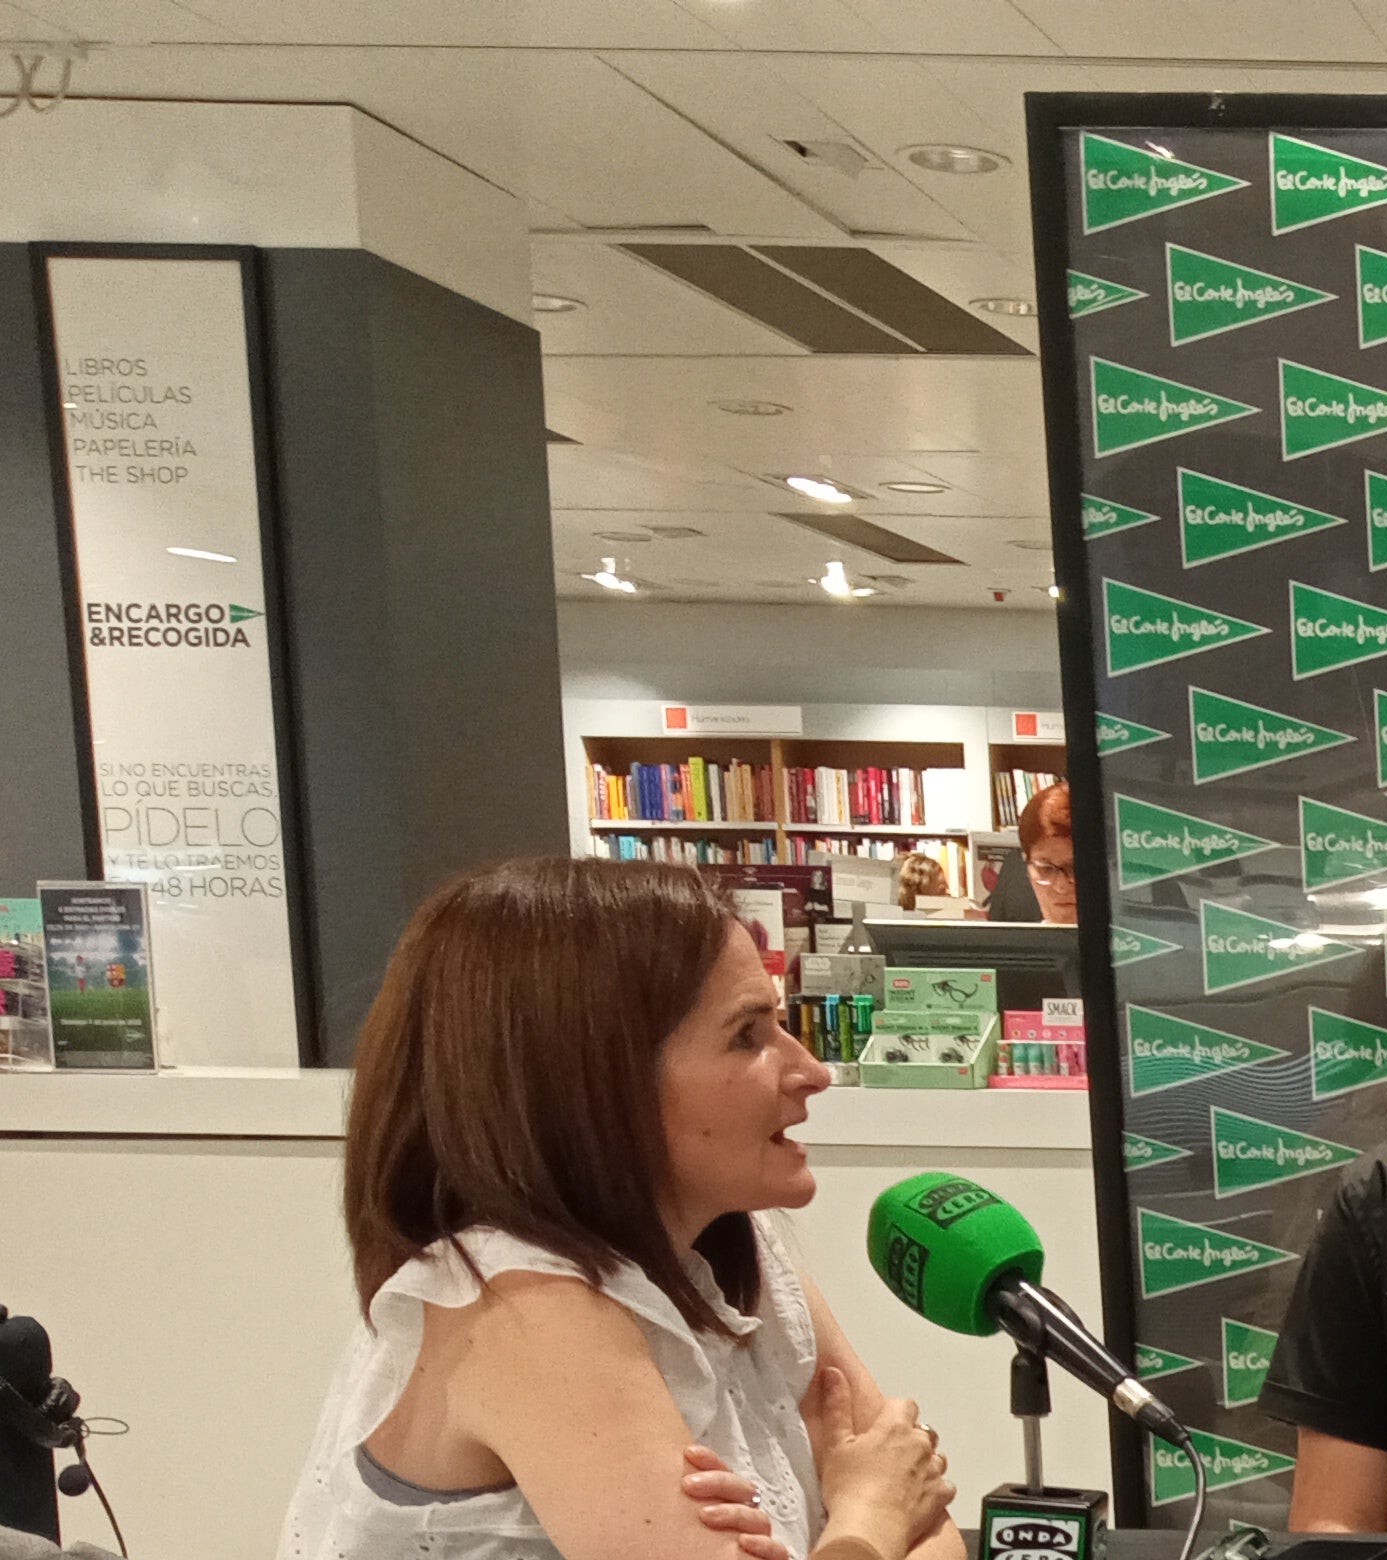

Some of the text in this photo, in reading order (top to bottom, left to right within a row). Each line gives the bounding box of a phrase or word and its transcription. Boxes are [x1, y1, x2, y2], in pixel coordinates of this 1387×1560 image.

[1086, 170, 1105, 190] El
[1106, 170, 1148, 190] Corte
[1276, 171, 1294, 191] El
[1295, 171, 1338, 191] Corte
[1173, 282, 1191, 302] El
[1192, 282, 1235, 302] Corte
[64, 358, 148, 376] LIBROS
[68, 382, 192, 404] PELÍCULAS
[1097, 395, 1115, 415] El
[1116, 395, 1159, 415] Corte
[1285, 397, 1304, 417] El
[1304, 398, 1346, 417] Corte
[71, 408, 158, 430] MÚSICA
[73, 436, 198, 458] PAPELERÍA
[75, 465, 189, 484] THE SHOP
[1184, 505, 1203, 525] El
[1203, 506, 1245, 525] Corte
[87, 603, 225, 624] ENCARGO
[1110, 615, 1129, 635] El
[1129, 616, 1171, 635] Corte
[1295, 618, 1314, 638] El
[1314, 619, 1356, 638] Corte
[90, 626, 251, 648] &RECOGIDA
[1196, 723, 1214, 743] El
[1215, 724, 1256, 743] Corte
[100, 763, 272, 778] SI NO ENCUENTRAS
[102, 780, 129, 797] LO
[136, 780, 181, 797] QUE
[103, 799, 280, 847] PÍDELO
[1122, 830, 1140, 849] El
[1141, 831, 1182, 849] Corte
[127, 854, 150, 870] TE
[154, 854, 180, 870] LO
[151, 876, 283, 898] 48 HORAS
[1133, 1039, 1151, 1058] El
[1152, 1040, 1192, 1058] Corte
[1315, 1040, 1333, 1060] El
[1334, 1041, 1374, 1060] Corte
[1217, 1139, 1235, 1159] El
[1236, 1140, 1276, 1159] Corte
[1144, 1242, 1162, 1261] El
[1162, 1243, 1202, 1261] Corte
[1002, 1529, 1067, 1544] ONDA
